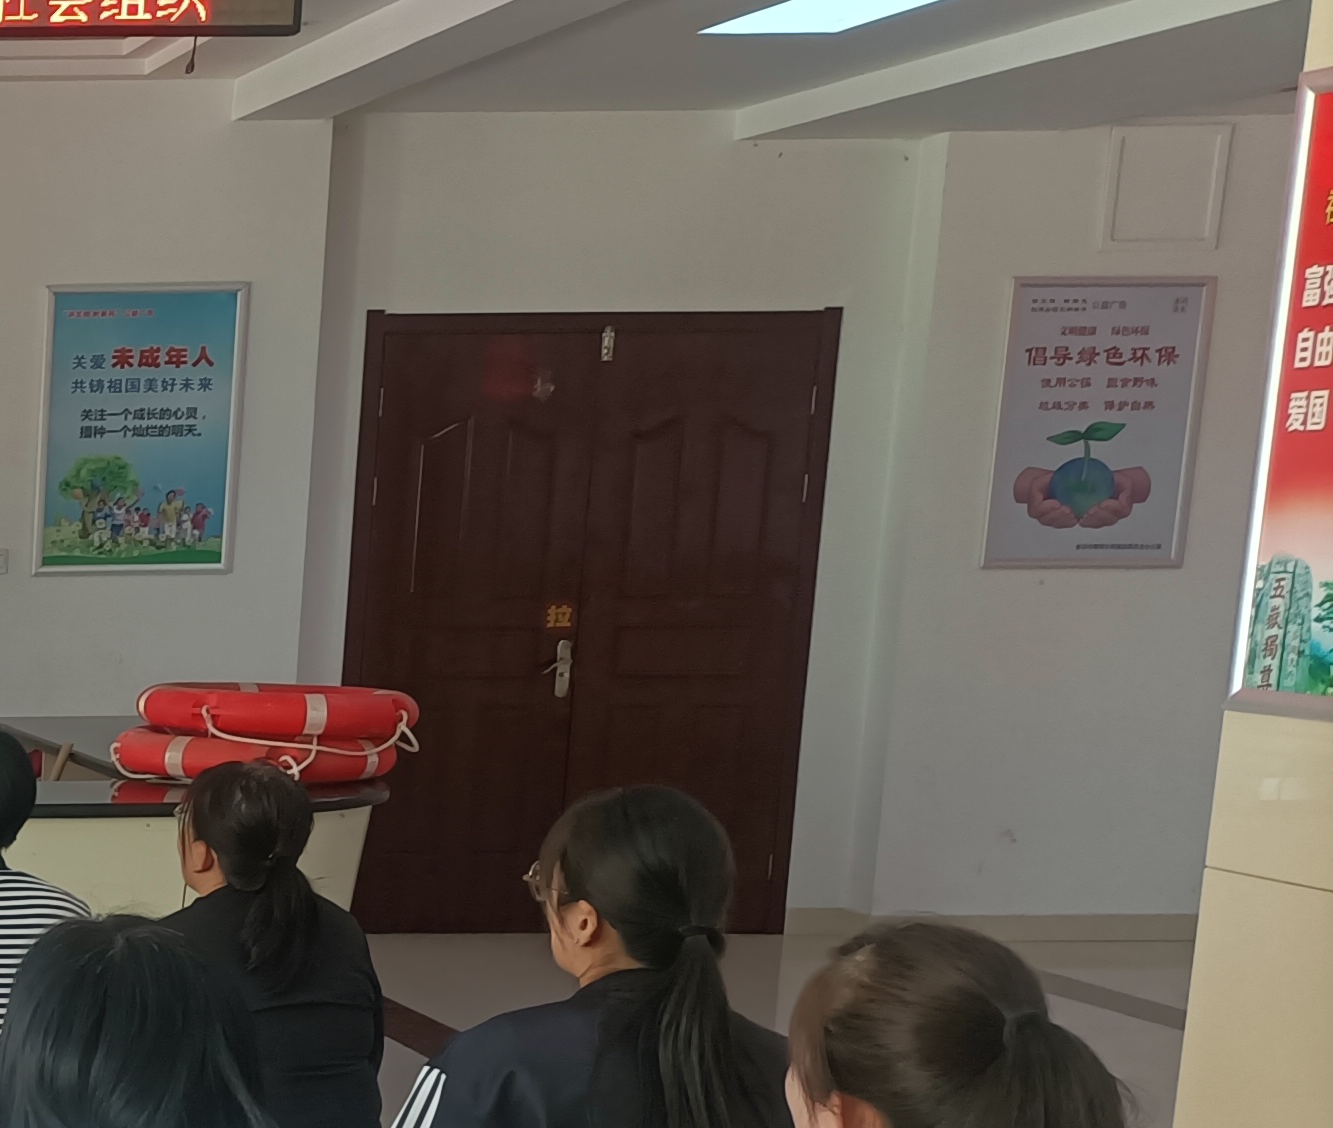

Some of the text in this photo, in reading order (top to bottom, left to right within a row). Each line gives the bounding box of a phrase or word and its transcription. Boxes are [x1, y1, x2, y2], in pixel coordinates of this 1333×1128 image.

[72, 345, 215, 370] 关爱 未成年人
[1025, 345, 1181, 367] 倡导绿色环保
[1293, 325, 1333, 369] 自由
[71, 376, 213, 395] 共铸祖国美好未来
[1285, 389, 1330, 433] 爱国
[546, 604, 573, 628] 拉
